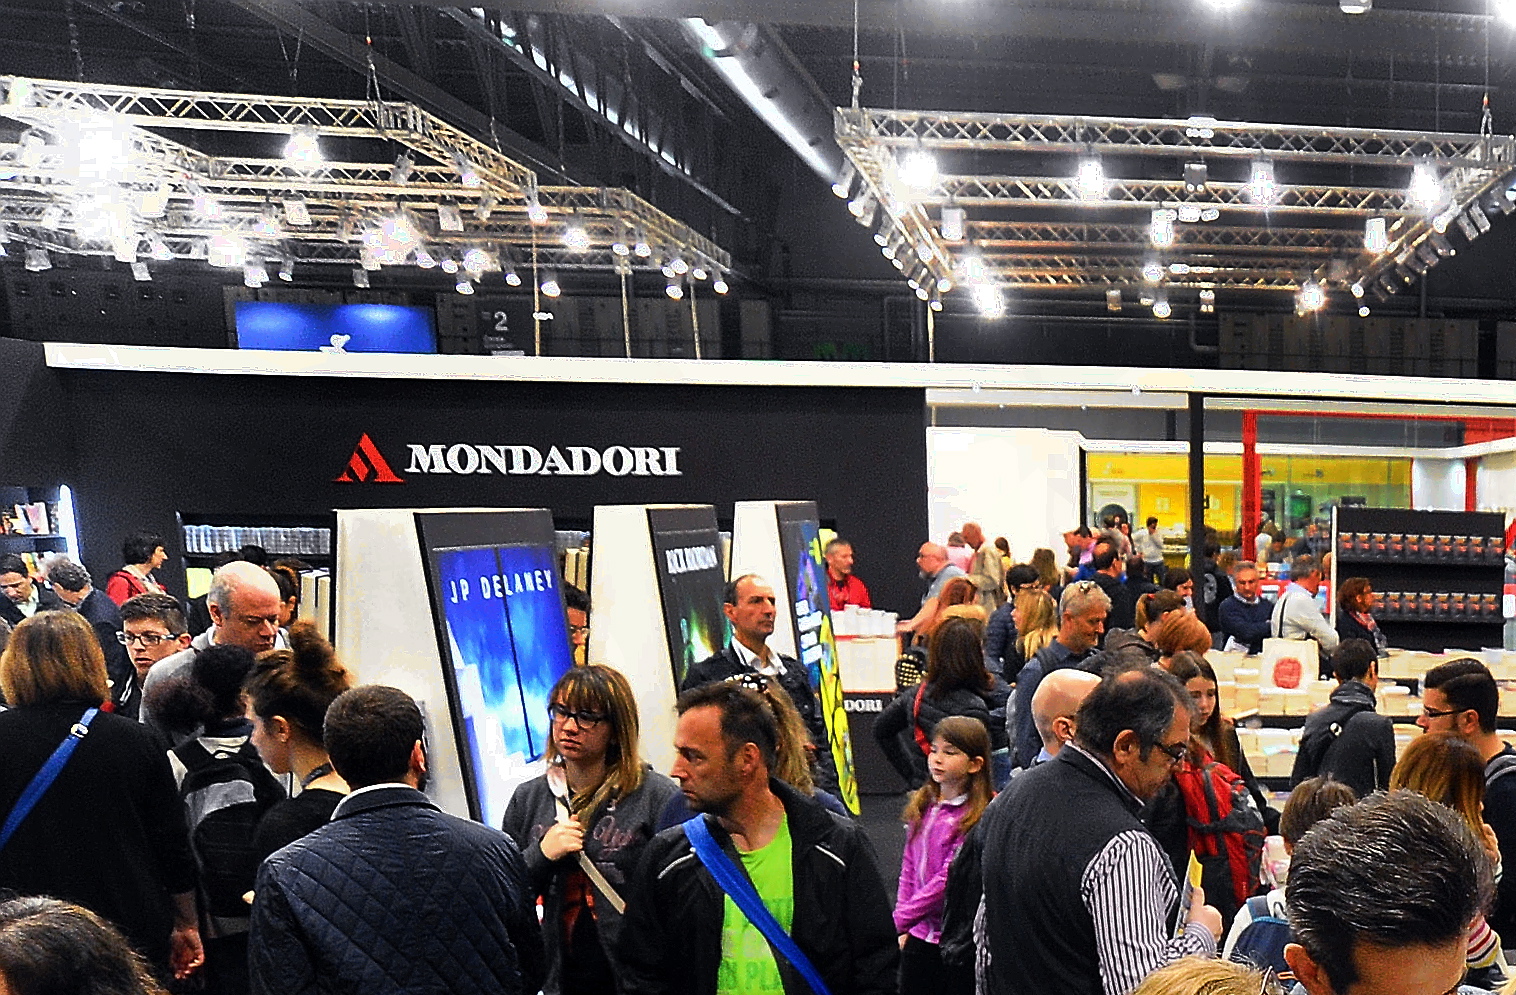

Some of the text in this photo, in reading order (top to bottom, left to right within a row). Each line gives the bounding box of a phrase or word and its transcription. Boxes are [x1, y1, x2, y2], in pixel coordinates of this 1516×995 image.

[405, 444, 682, 476] MONDADORI
[450, 568, 552, 604] JP DELANEY
